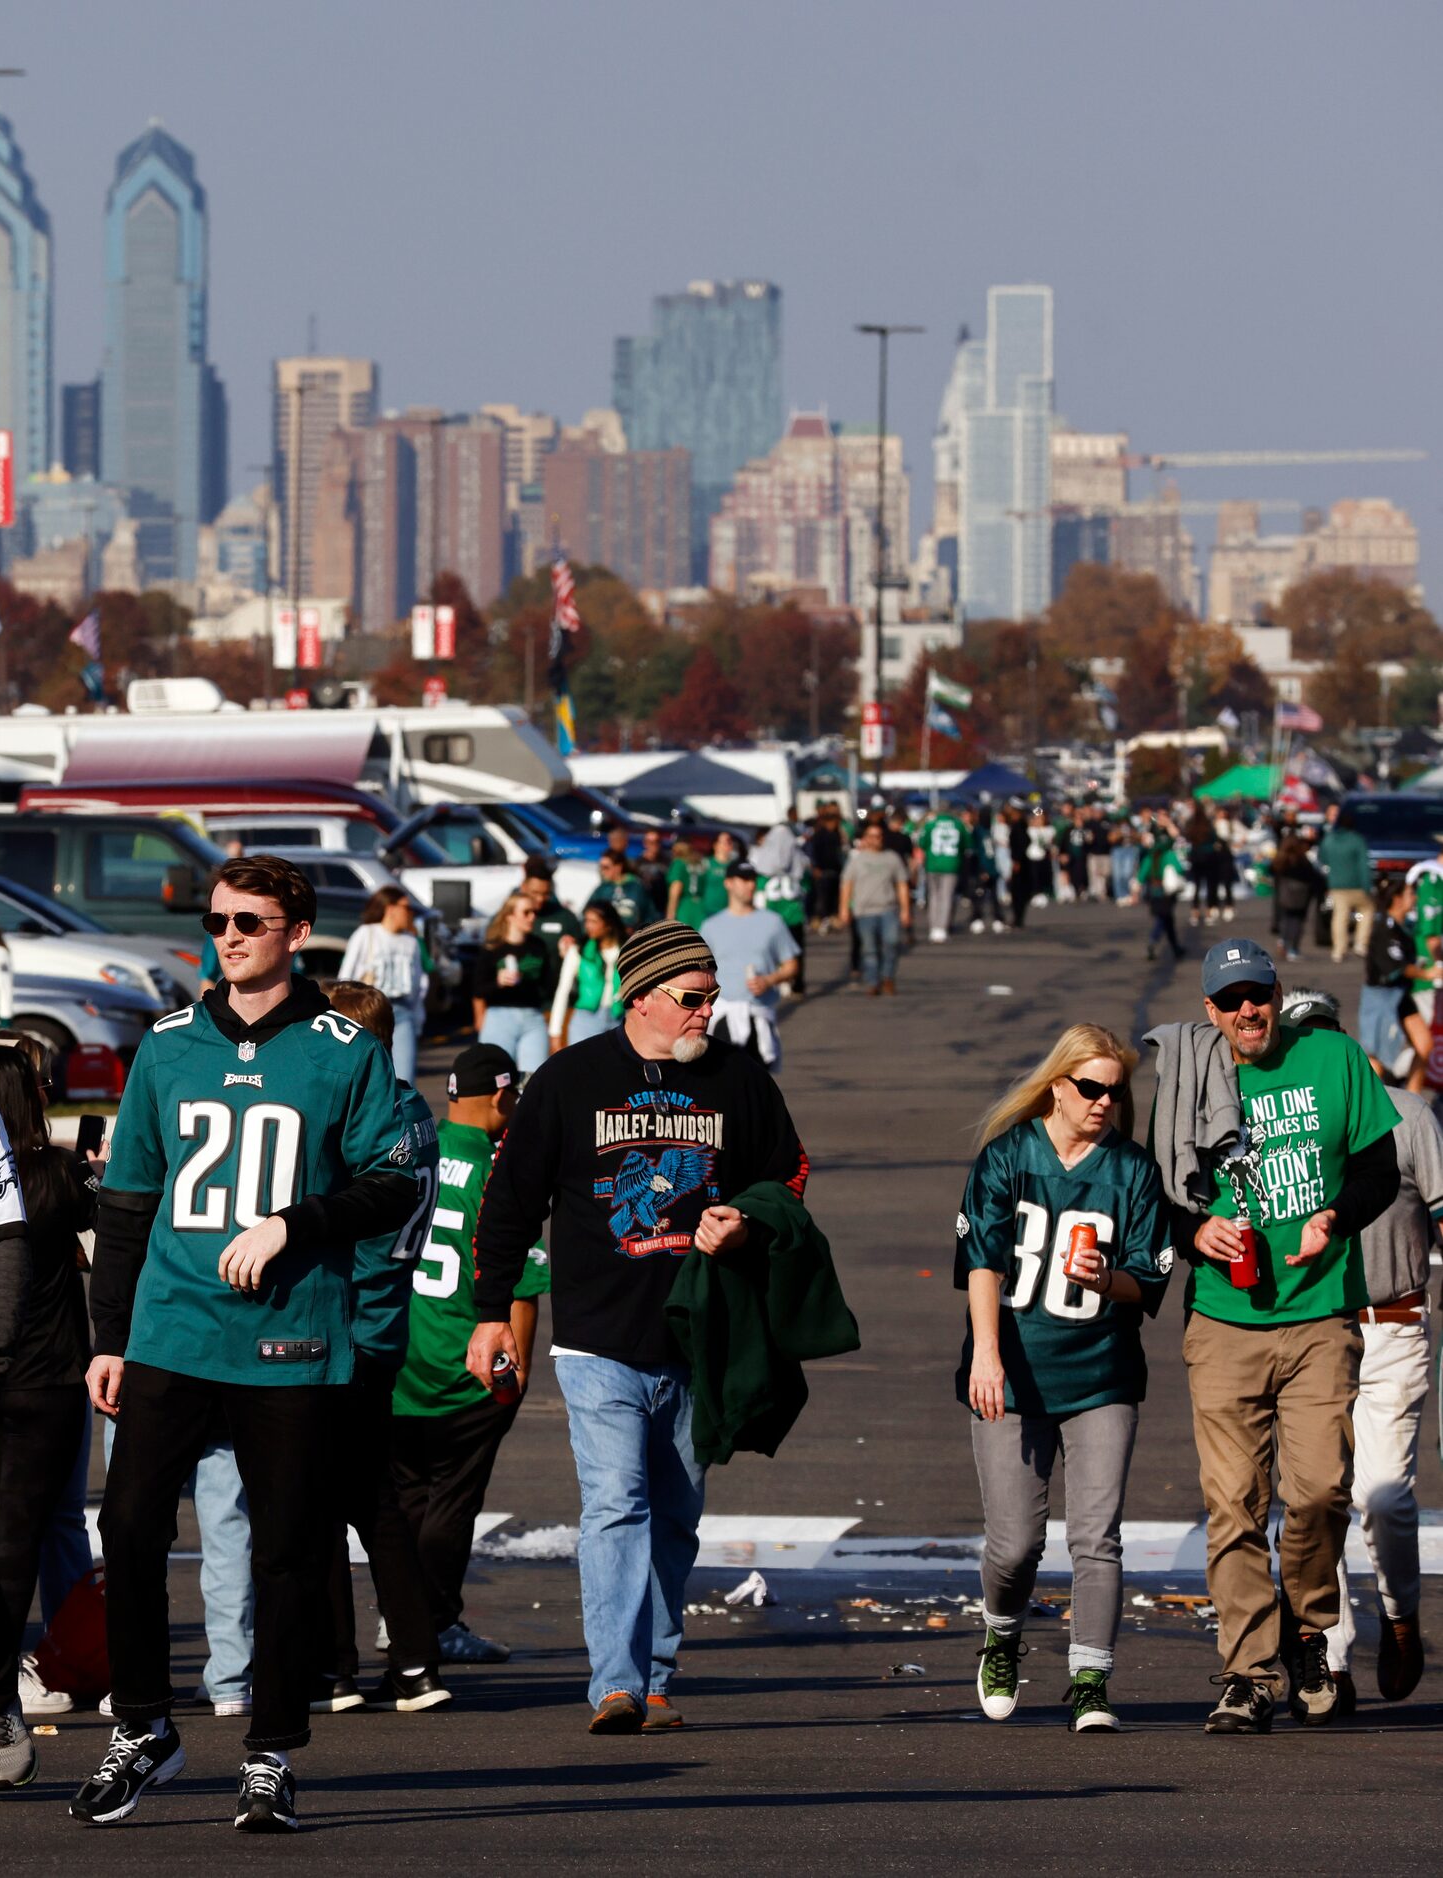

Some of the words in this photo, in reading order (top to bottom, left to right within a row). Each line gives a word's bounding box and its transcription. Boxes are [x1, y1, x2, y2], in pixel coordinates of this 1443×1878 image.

[223, 1073, 264, 1088] EAGLES
[1251, 1094, 1278, 1123] NO
[1281, 1086, 1319, 1116] ONE
[594, 1109, 725, 1151] HARLEY-DAVIDSON
[1267, 1117, 1302, 1138] LIKES
[1303, 1114, 1320, 1131] US
[172, 1100, 308, 1233] 20
[439, 1157, 474, 1189] SON
[1264, 1146, 1323, 1191] DON'T
[593, 1181, 614, 1195] SINCE
[1271, 1177, 1325, 1220] CARE!
[664, 1235, 691, 1248] QUALITY
